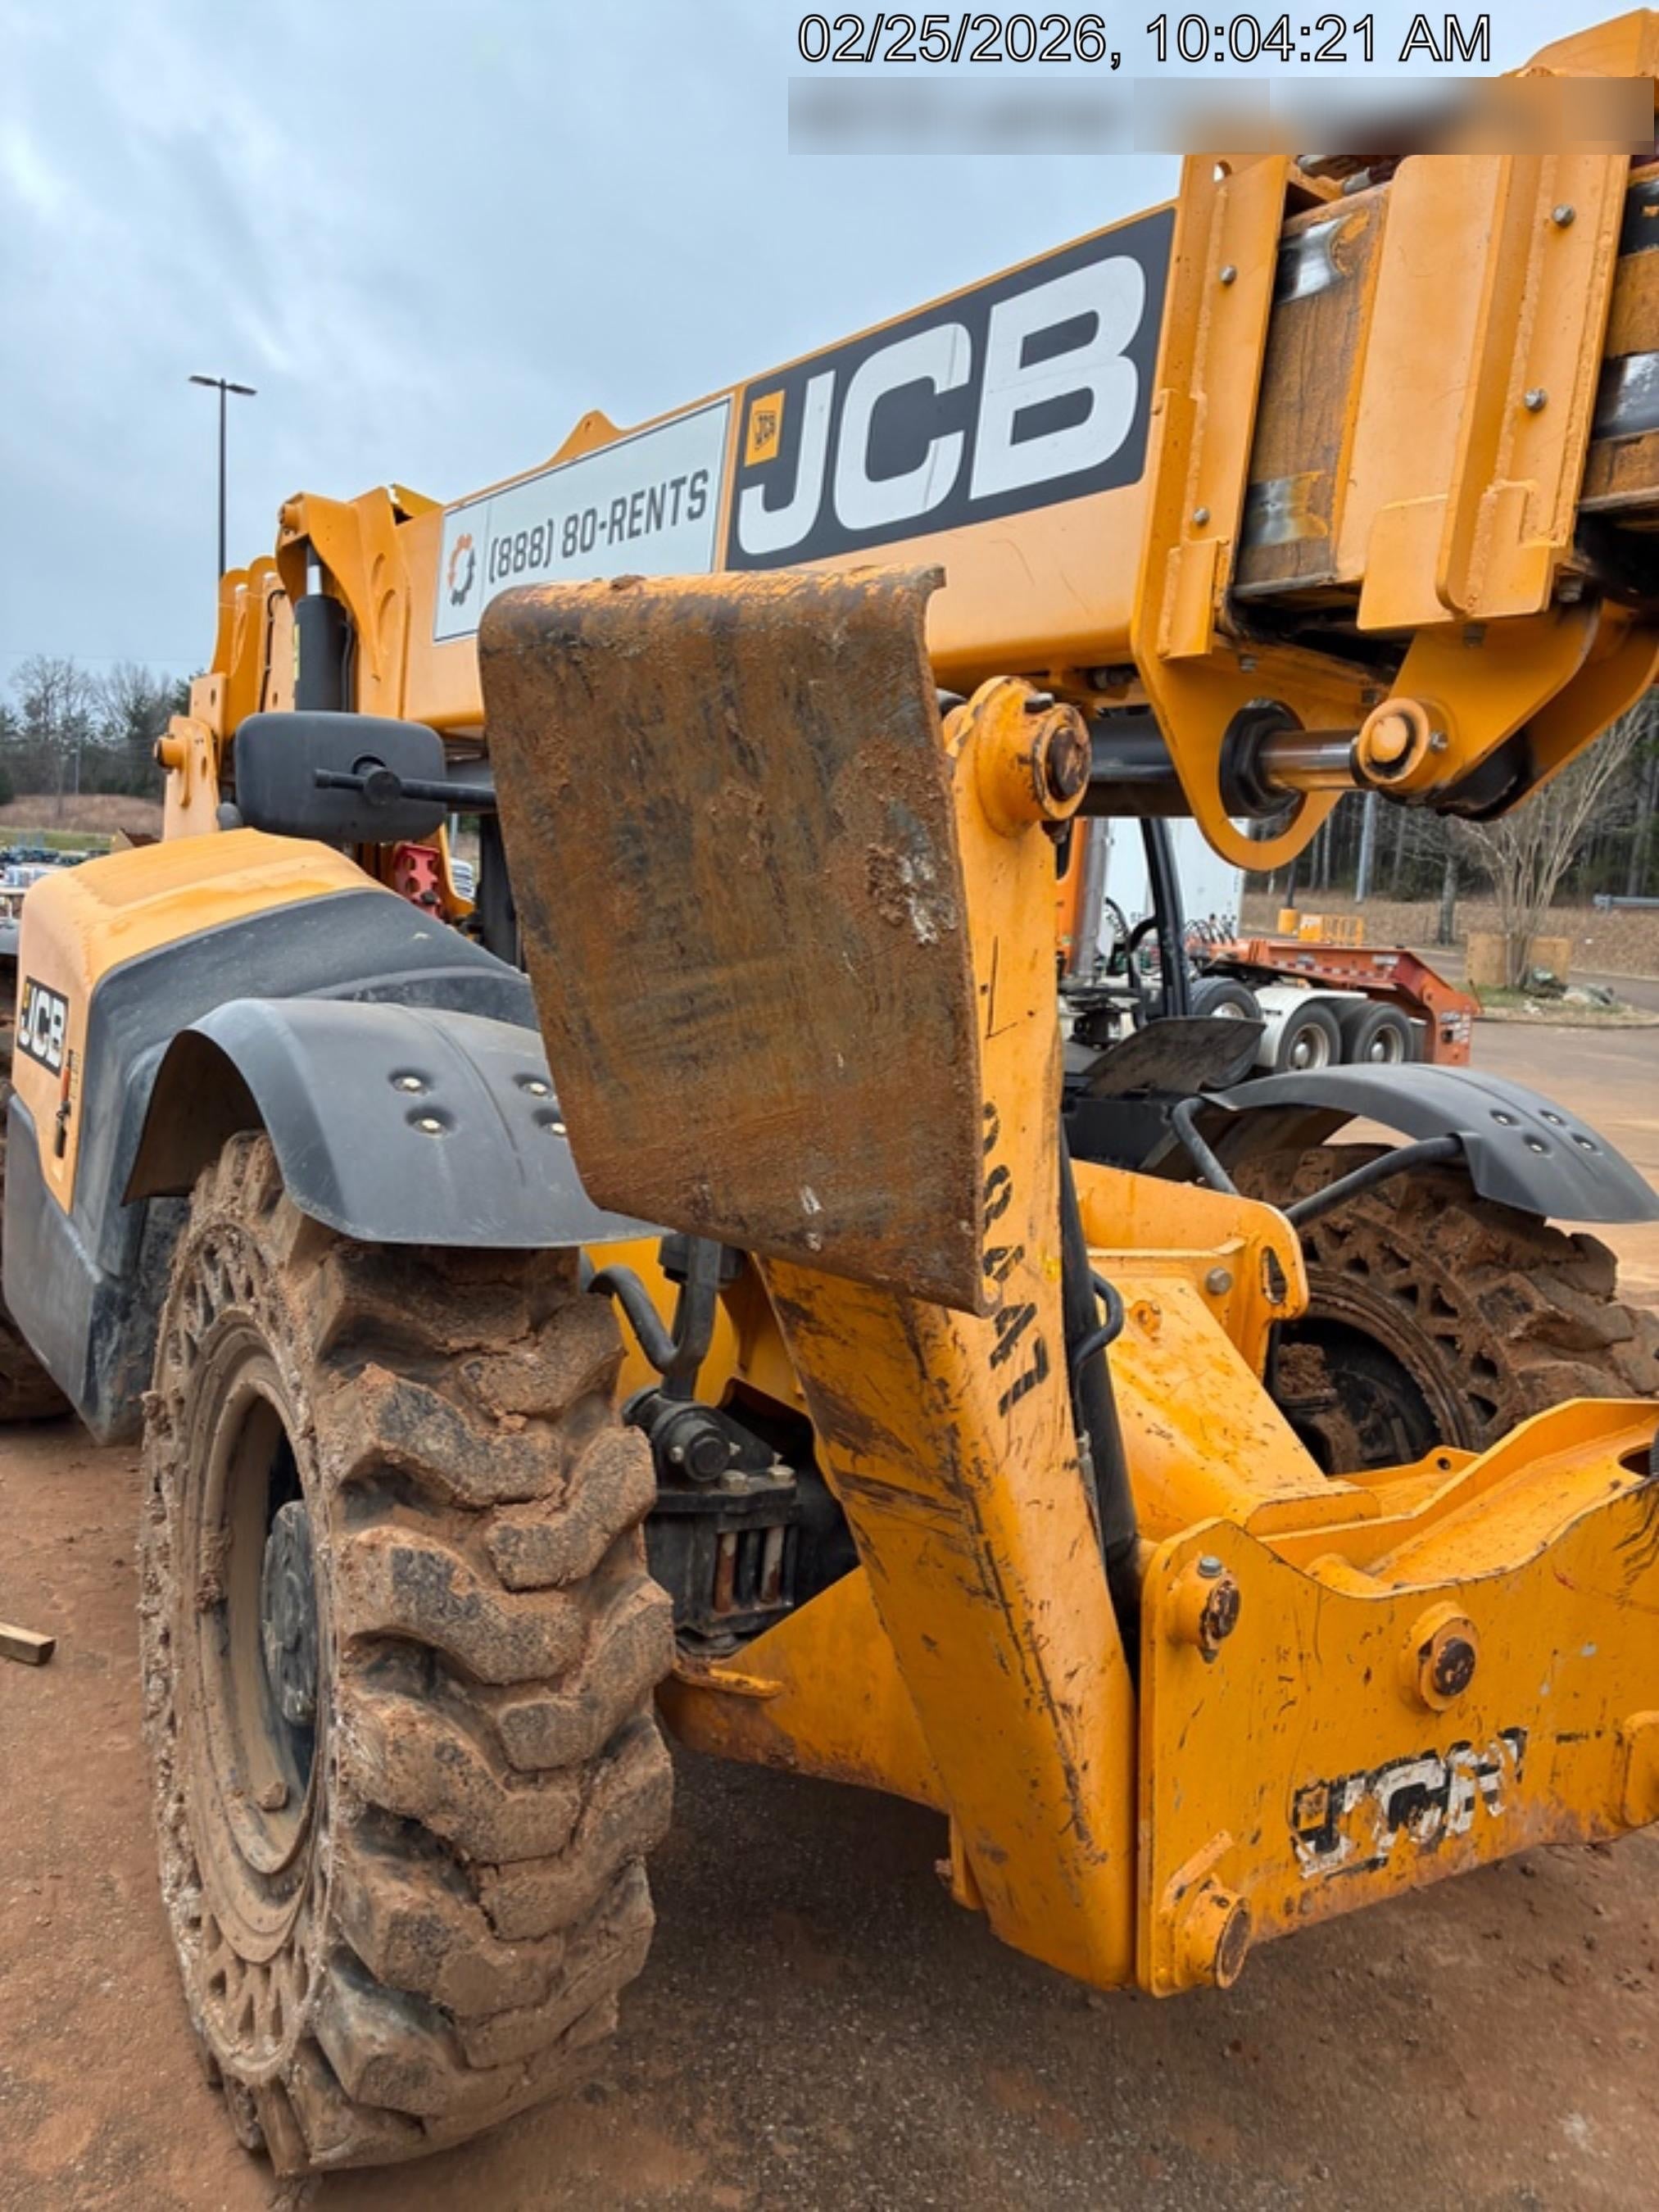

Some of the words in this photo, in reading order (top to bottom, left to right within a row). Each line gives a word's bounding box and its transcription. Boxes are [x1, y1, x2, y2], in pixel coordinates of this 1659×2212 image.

[738, 255, 1145, 555] JCB
[488, 518, 554, 583] (888)
[562, 469, 709, 559] 80-RENTS
[19, 986, 66, 1068] JCB
